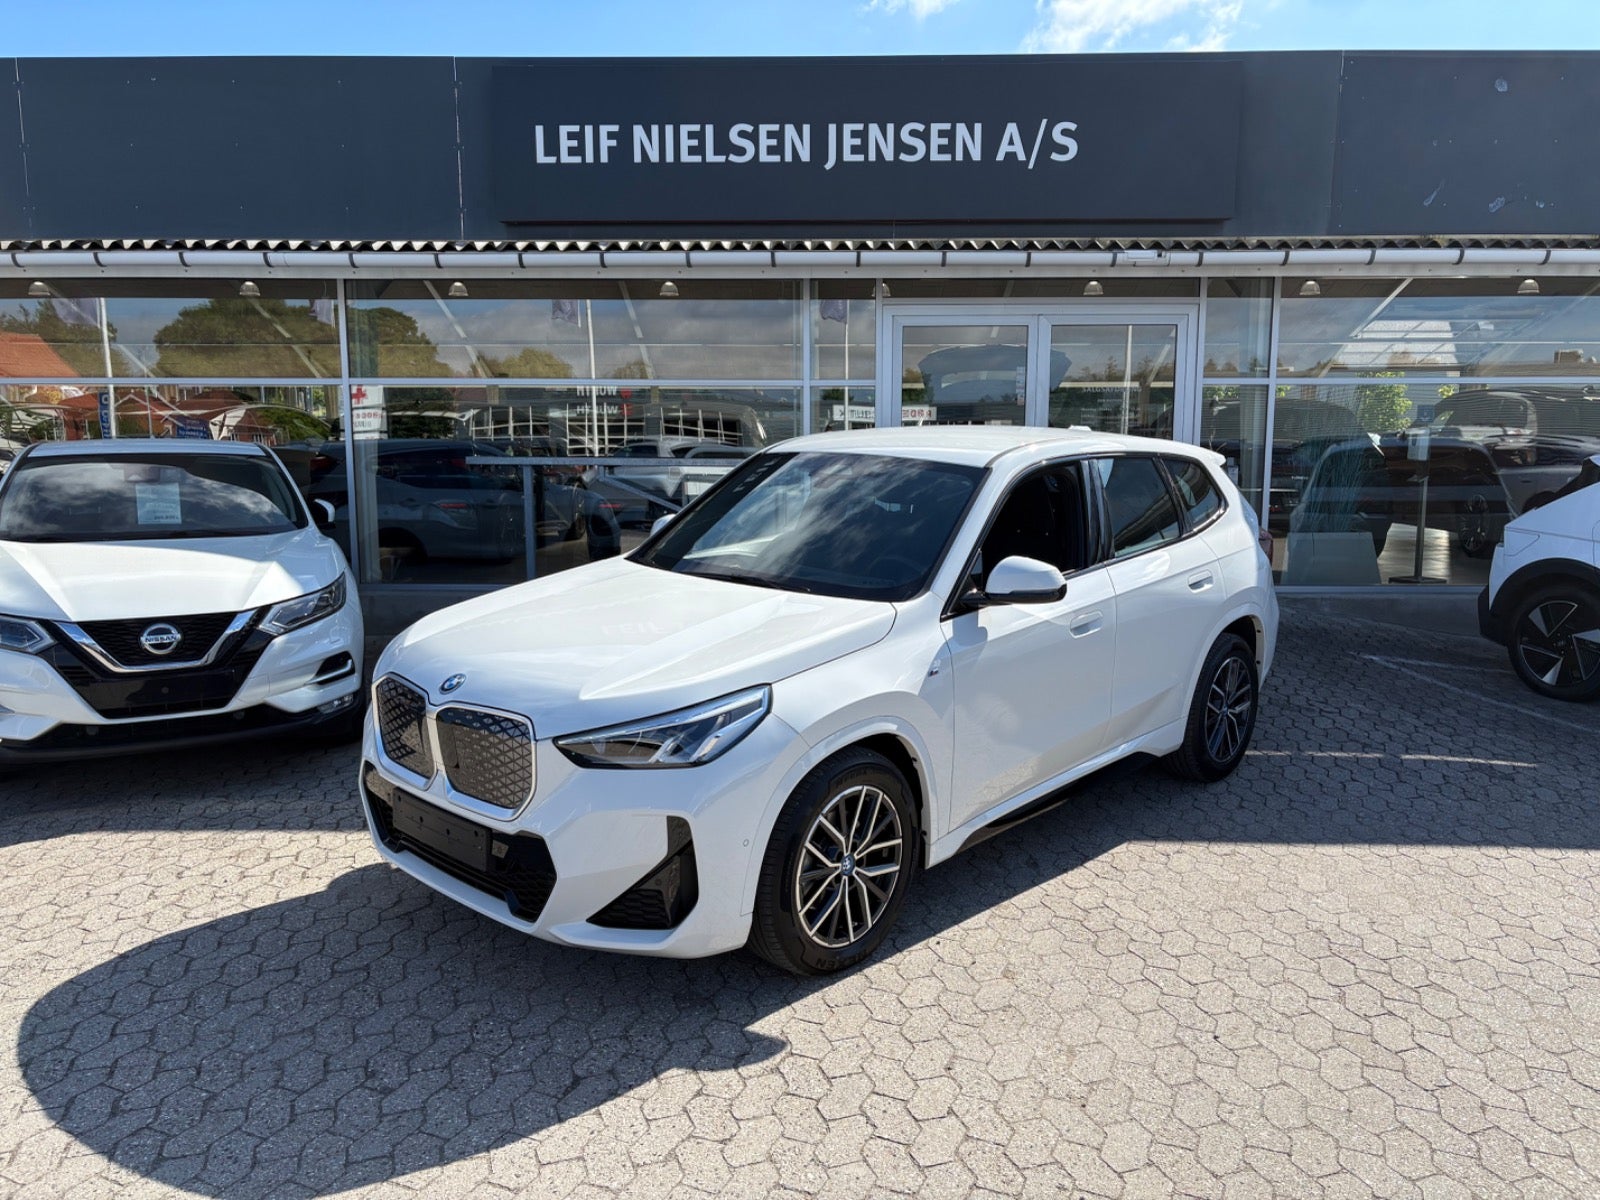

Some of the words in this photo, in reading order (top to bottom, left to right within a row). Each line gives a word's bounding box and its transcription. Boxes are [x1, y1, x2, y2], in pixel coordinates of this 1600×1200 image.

[535, 124, 620, 164] LEIF
[632, 123, 811, 163] NIELSEN
[824, 122, 982, 169] JENSEN
[995, 118, 1078, 169] A/S
[144, 634, 177, 643] NISSAN
